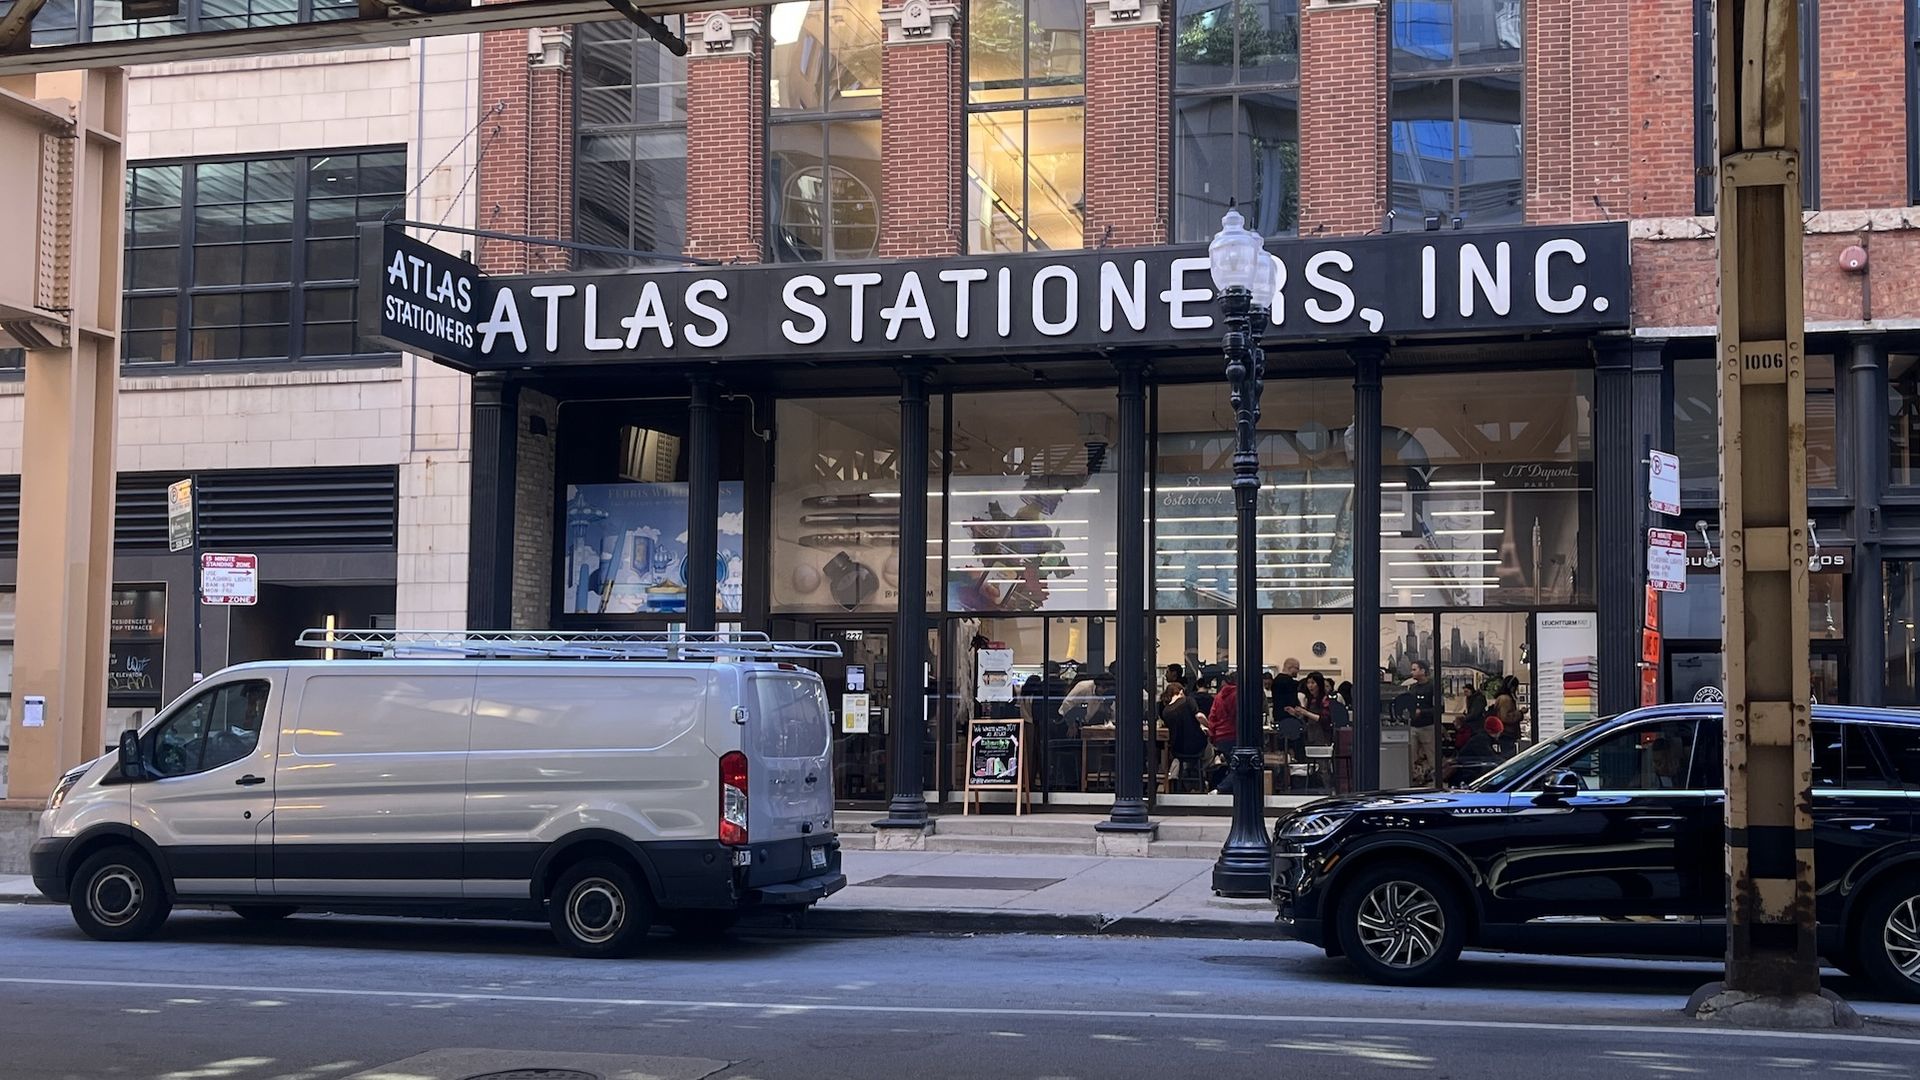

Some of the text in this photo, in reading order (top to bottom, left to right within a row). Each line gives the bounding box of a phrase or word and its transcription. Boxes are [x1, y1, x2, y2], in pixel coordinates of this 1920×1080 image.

[387, 249, 472, 313] ATLAS
[477, 278, 729, 353] ATLAS
[1421, 238, 1609, 319] INC.
[385, 294, 474, 348] STATIONERS
[1745, 353, 1783, 370] 1006
[1528, 463, 1579, 478] Dupont
[1163, 491, 1222, 506] Esterbrook
[846, 631, 863, 641] 227
